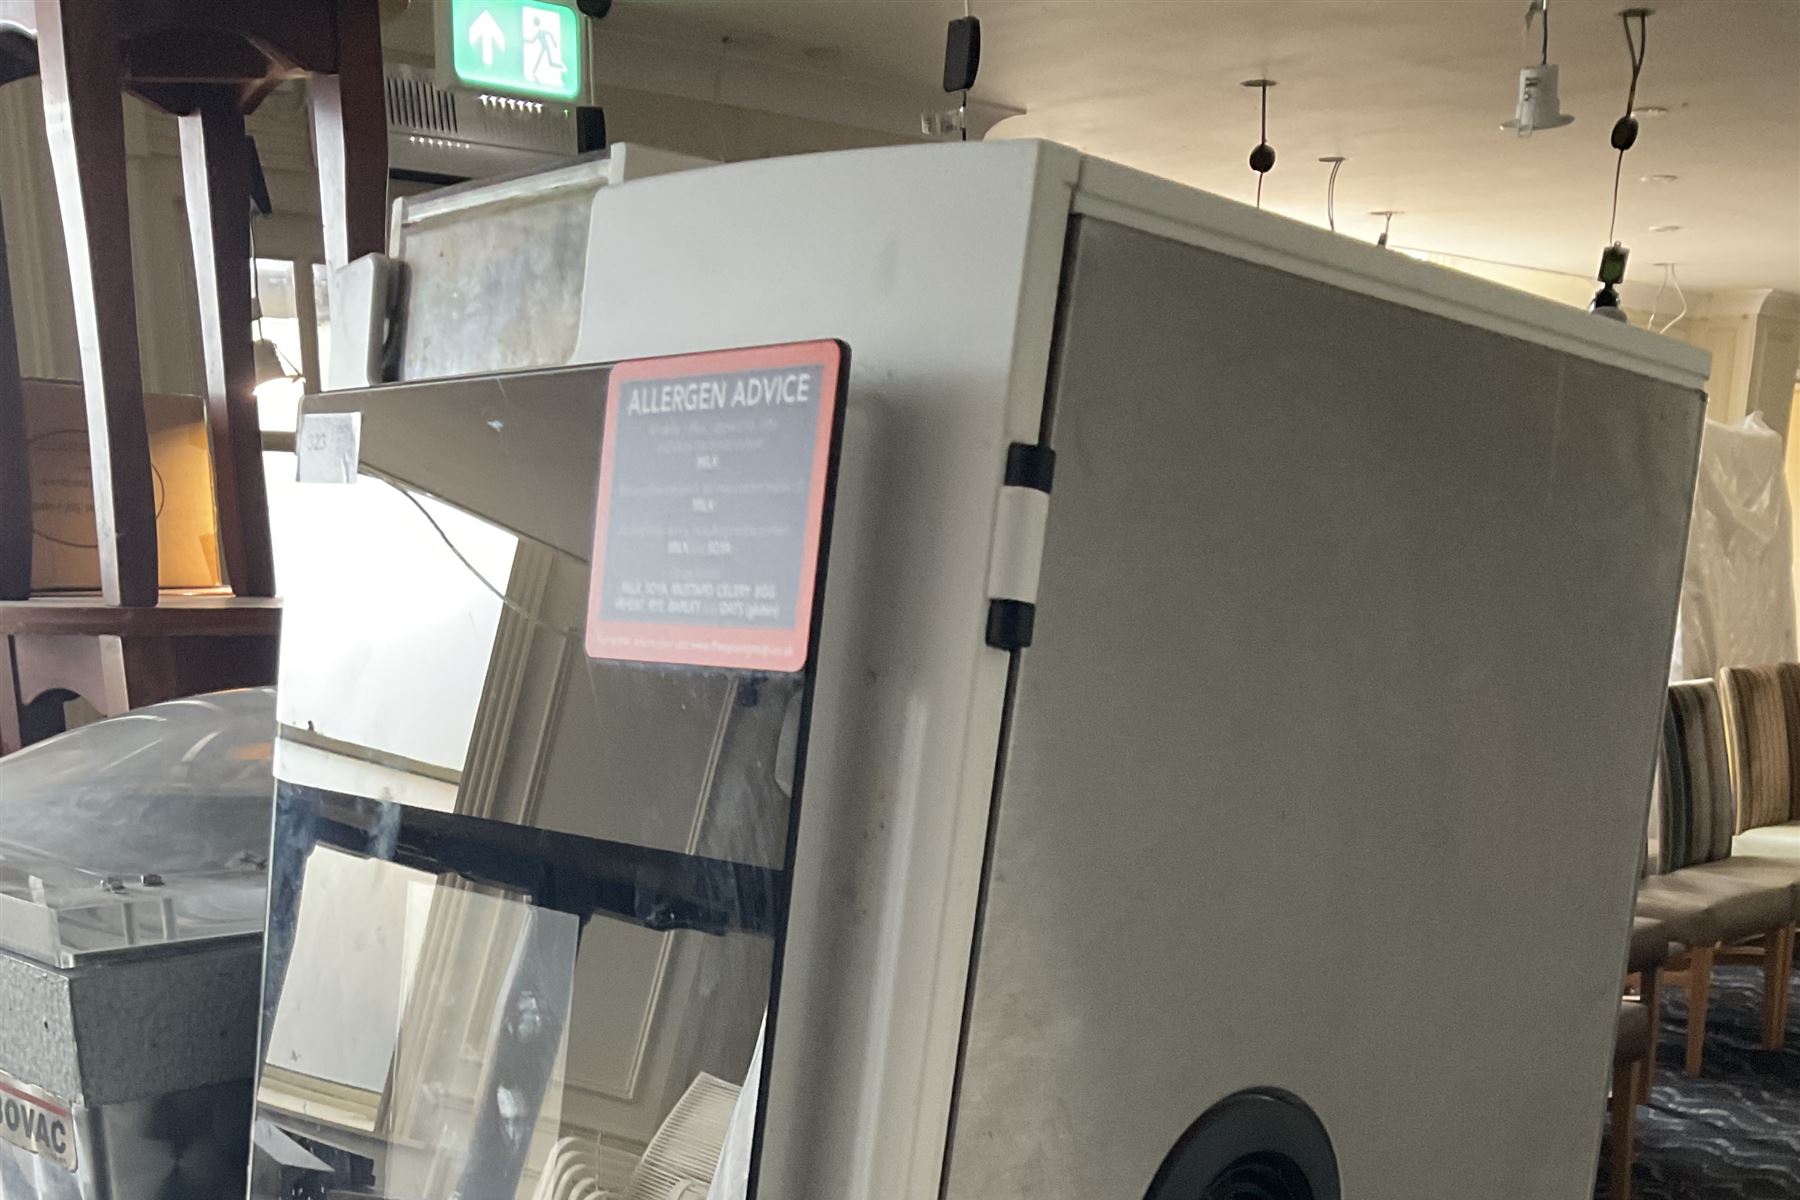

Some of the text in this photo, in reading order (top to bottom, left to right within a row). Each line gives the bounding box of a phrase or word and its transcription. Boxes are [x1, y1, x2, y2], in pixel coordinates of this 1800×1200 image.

[628, 373, 811, 416] ALLERGEN ADVICE
[0, 1096, 66, 1153] OVAC
